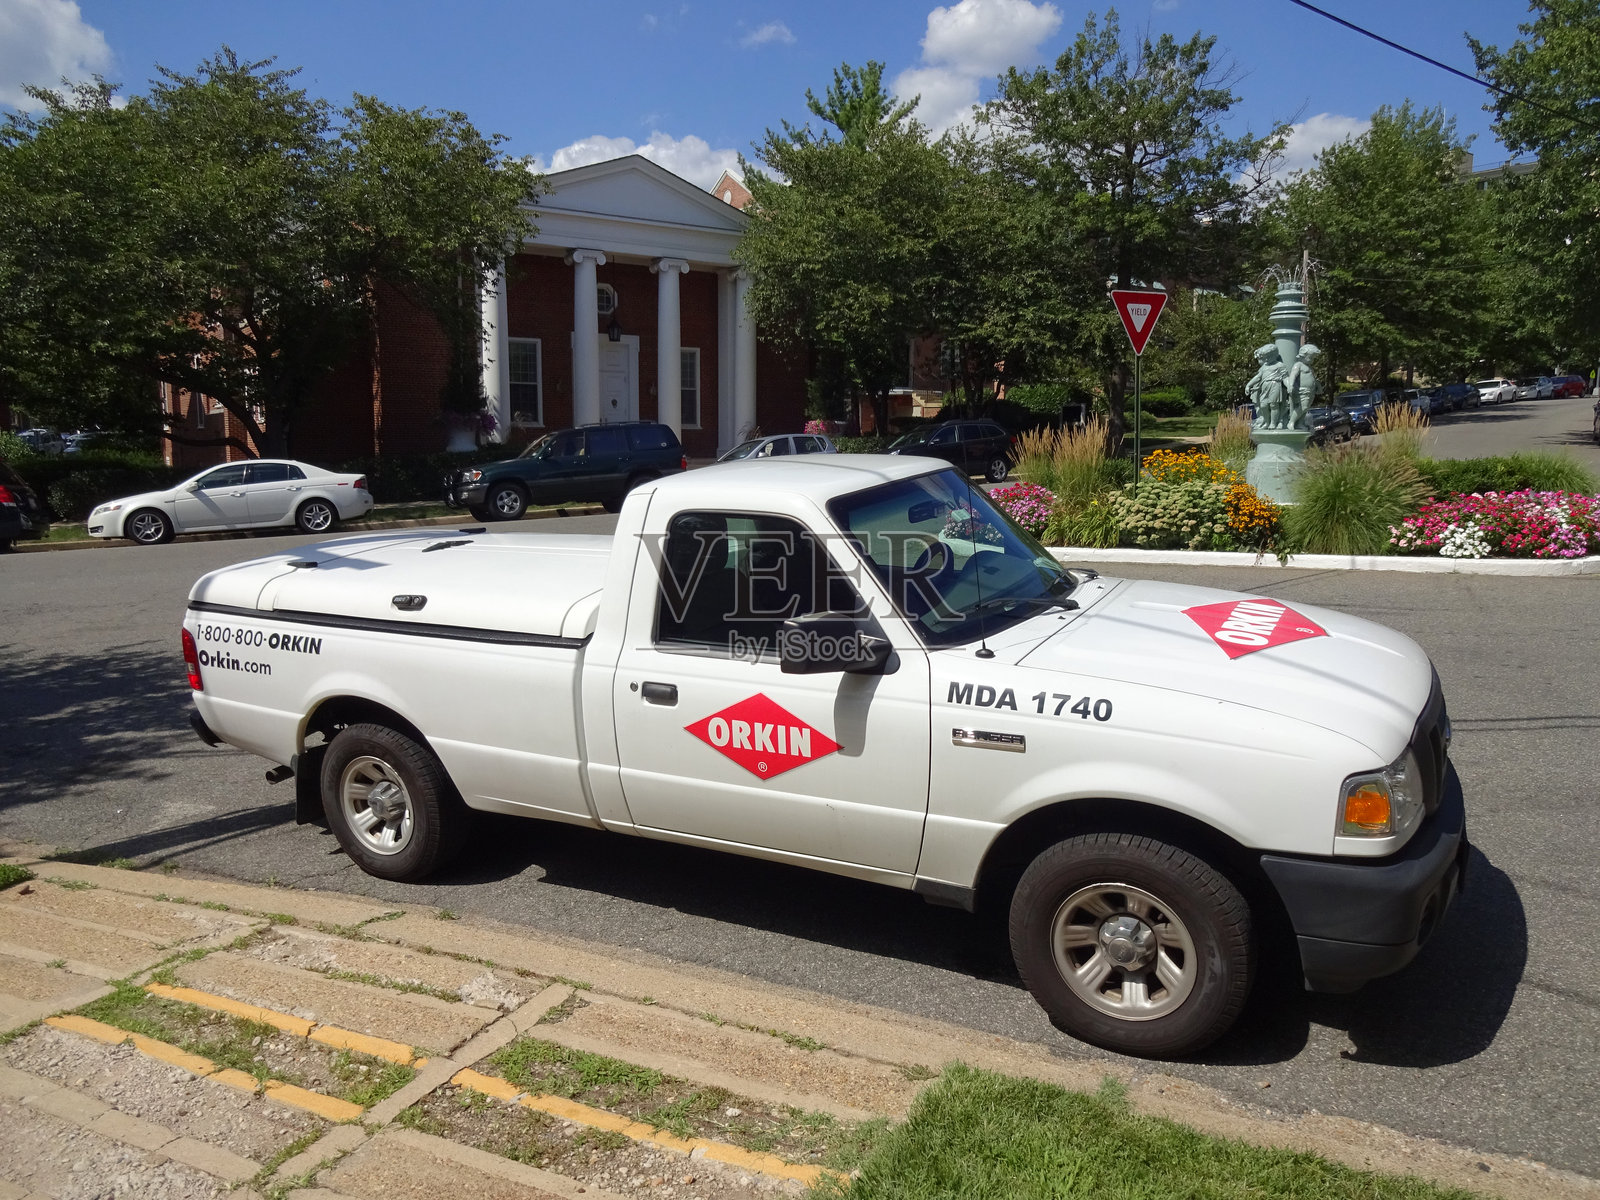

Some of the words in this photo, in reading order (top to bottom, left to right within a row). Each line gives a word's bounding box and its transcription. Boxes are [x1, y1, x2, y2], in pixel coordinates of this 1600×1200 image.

[1130, 307, 1148, 316] YIELD
[1214, 601, 1287, 646] ORKIN
[198, 649, 272, 675] Orkin.com
[947, 681, 1018, 711] MDA
[1031, 691, 1113, 722] 1740
[708, 716, 812, 758] ORKIN
